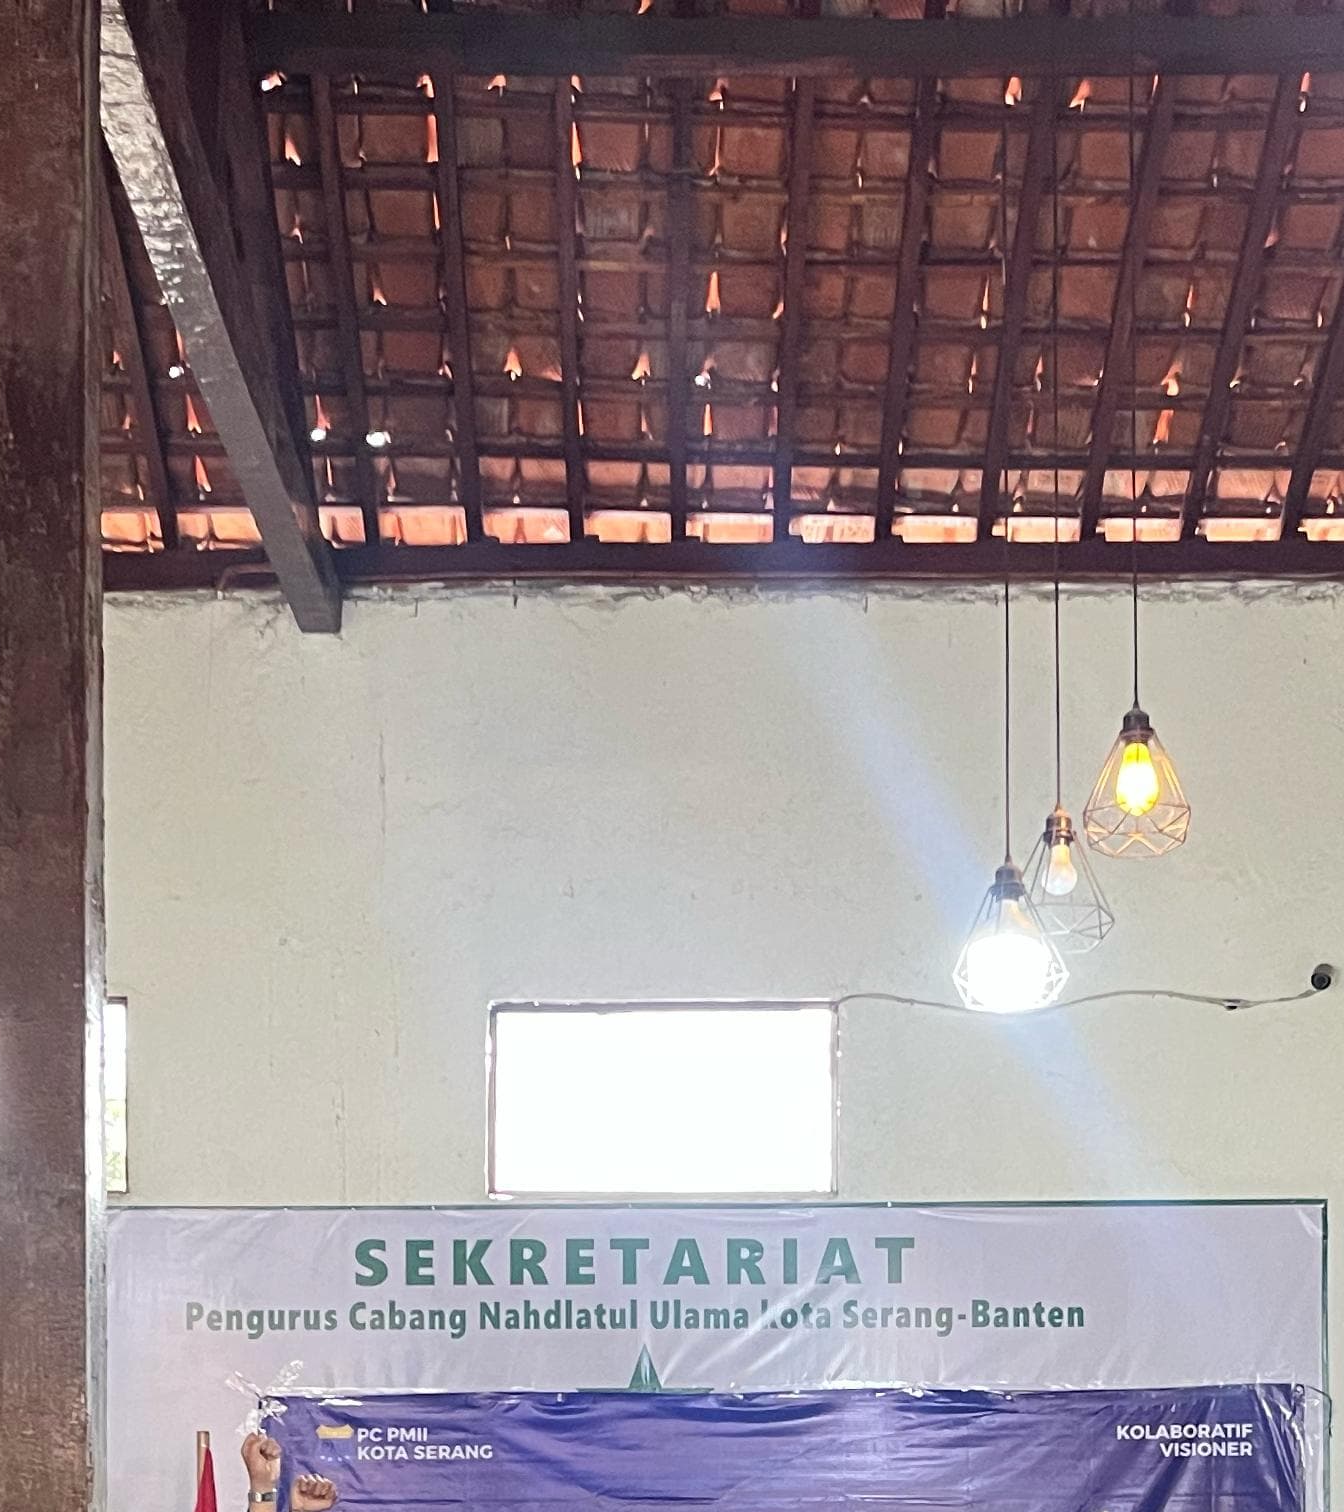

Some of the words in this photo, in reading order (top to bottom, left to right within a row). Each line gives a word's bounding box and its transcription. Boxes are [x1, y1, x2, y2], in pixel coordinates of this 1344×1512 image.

[355, 1237, 915, 1286] SEKRETARIAT
[186, 1301, 338, 1339] Pengurus
[349, 1300, 467, 1338] Cabang
[479, 1300, 637, 1330] Nahdlatul
[650, 1300, 749, 1330] Ulama
[842, 1299, 1085, 1338] Serang-Banten
[357, 1428, 382, 1442] PC
[387, 1427, 428, 1442] PMII
[1116, 1423, 1253, 1440] KOLABORATIF
[357, 1446, 409, 1460] KOTA
[414, 1445, 493, 1460] SERANG
[1160, 1441, 1253, 1457] VISIONER
